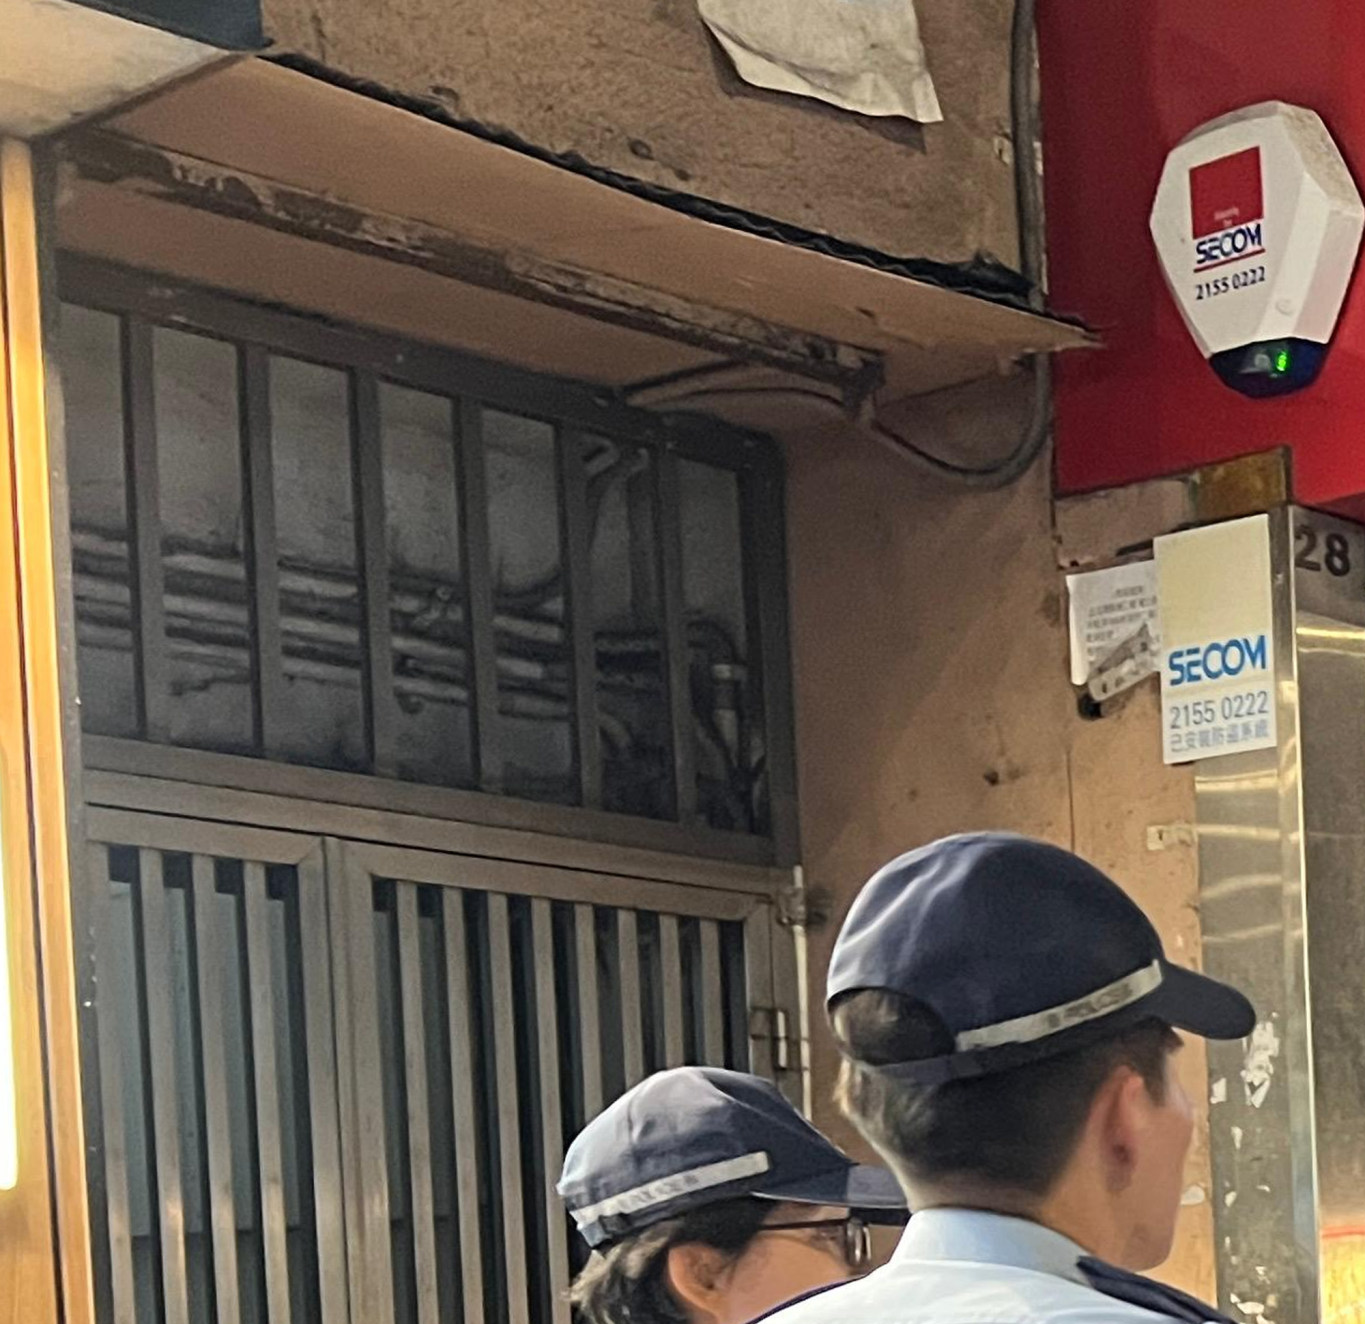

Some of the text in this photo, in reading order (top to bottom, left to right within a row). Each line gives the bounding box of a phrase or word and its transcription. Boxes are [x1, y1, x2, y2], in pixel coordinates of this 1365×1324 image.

[1196, 223, 1263, 264] SECOM
[1196, 266, 1266, 300] 2155 0222
[1295, 527, 1350, 576] 28
[1168, 635, 1267, 686] SECOM
[1170, 691, 1269, 729] 2155 0222
